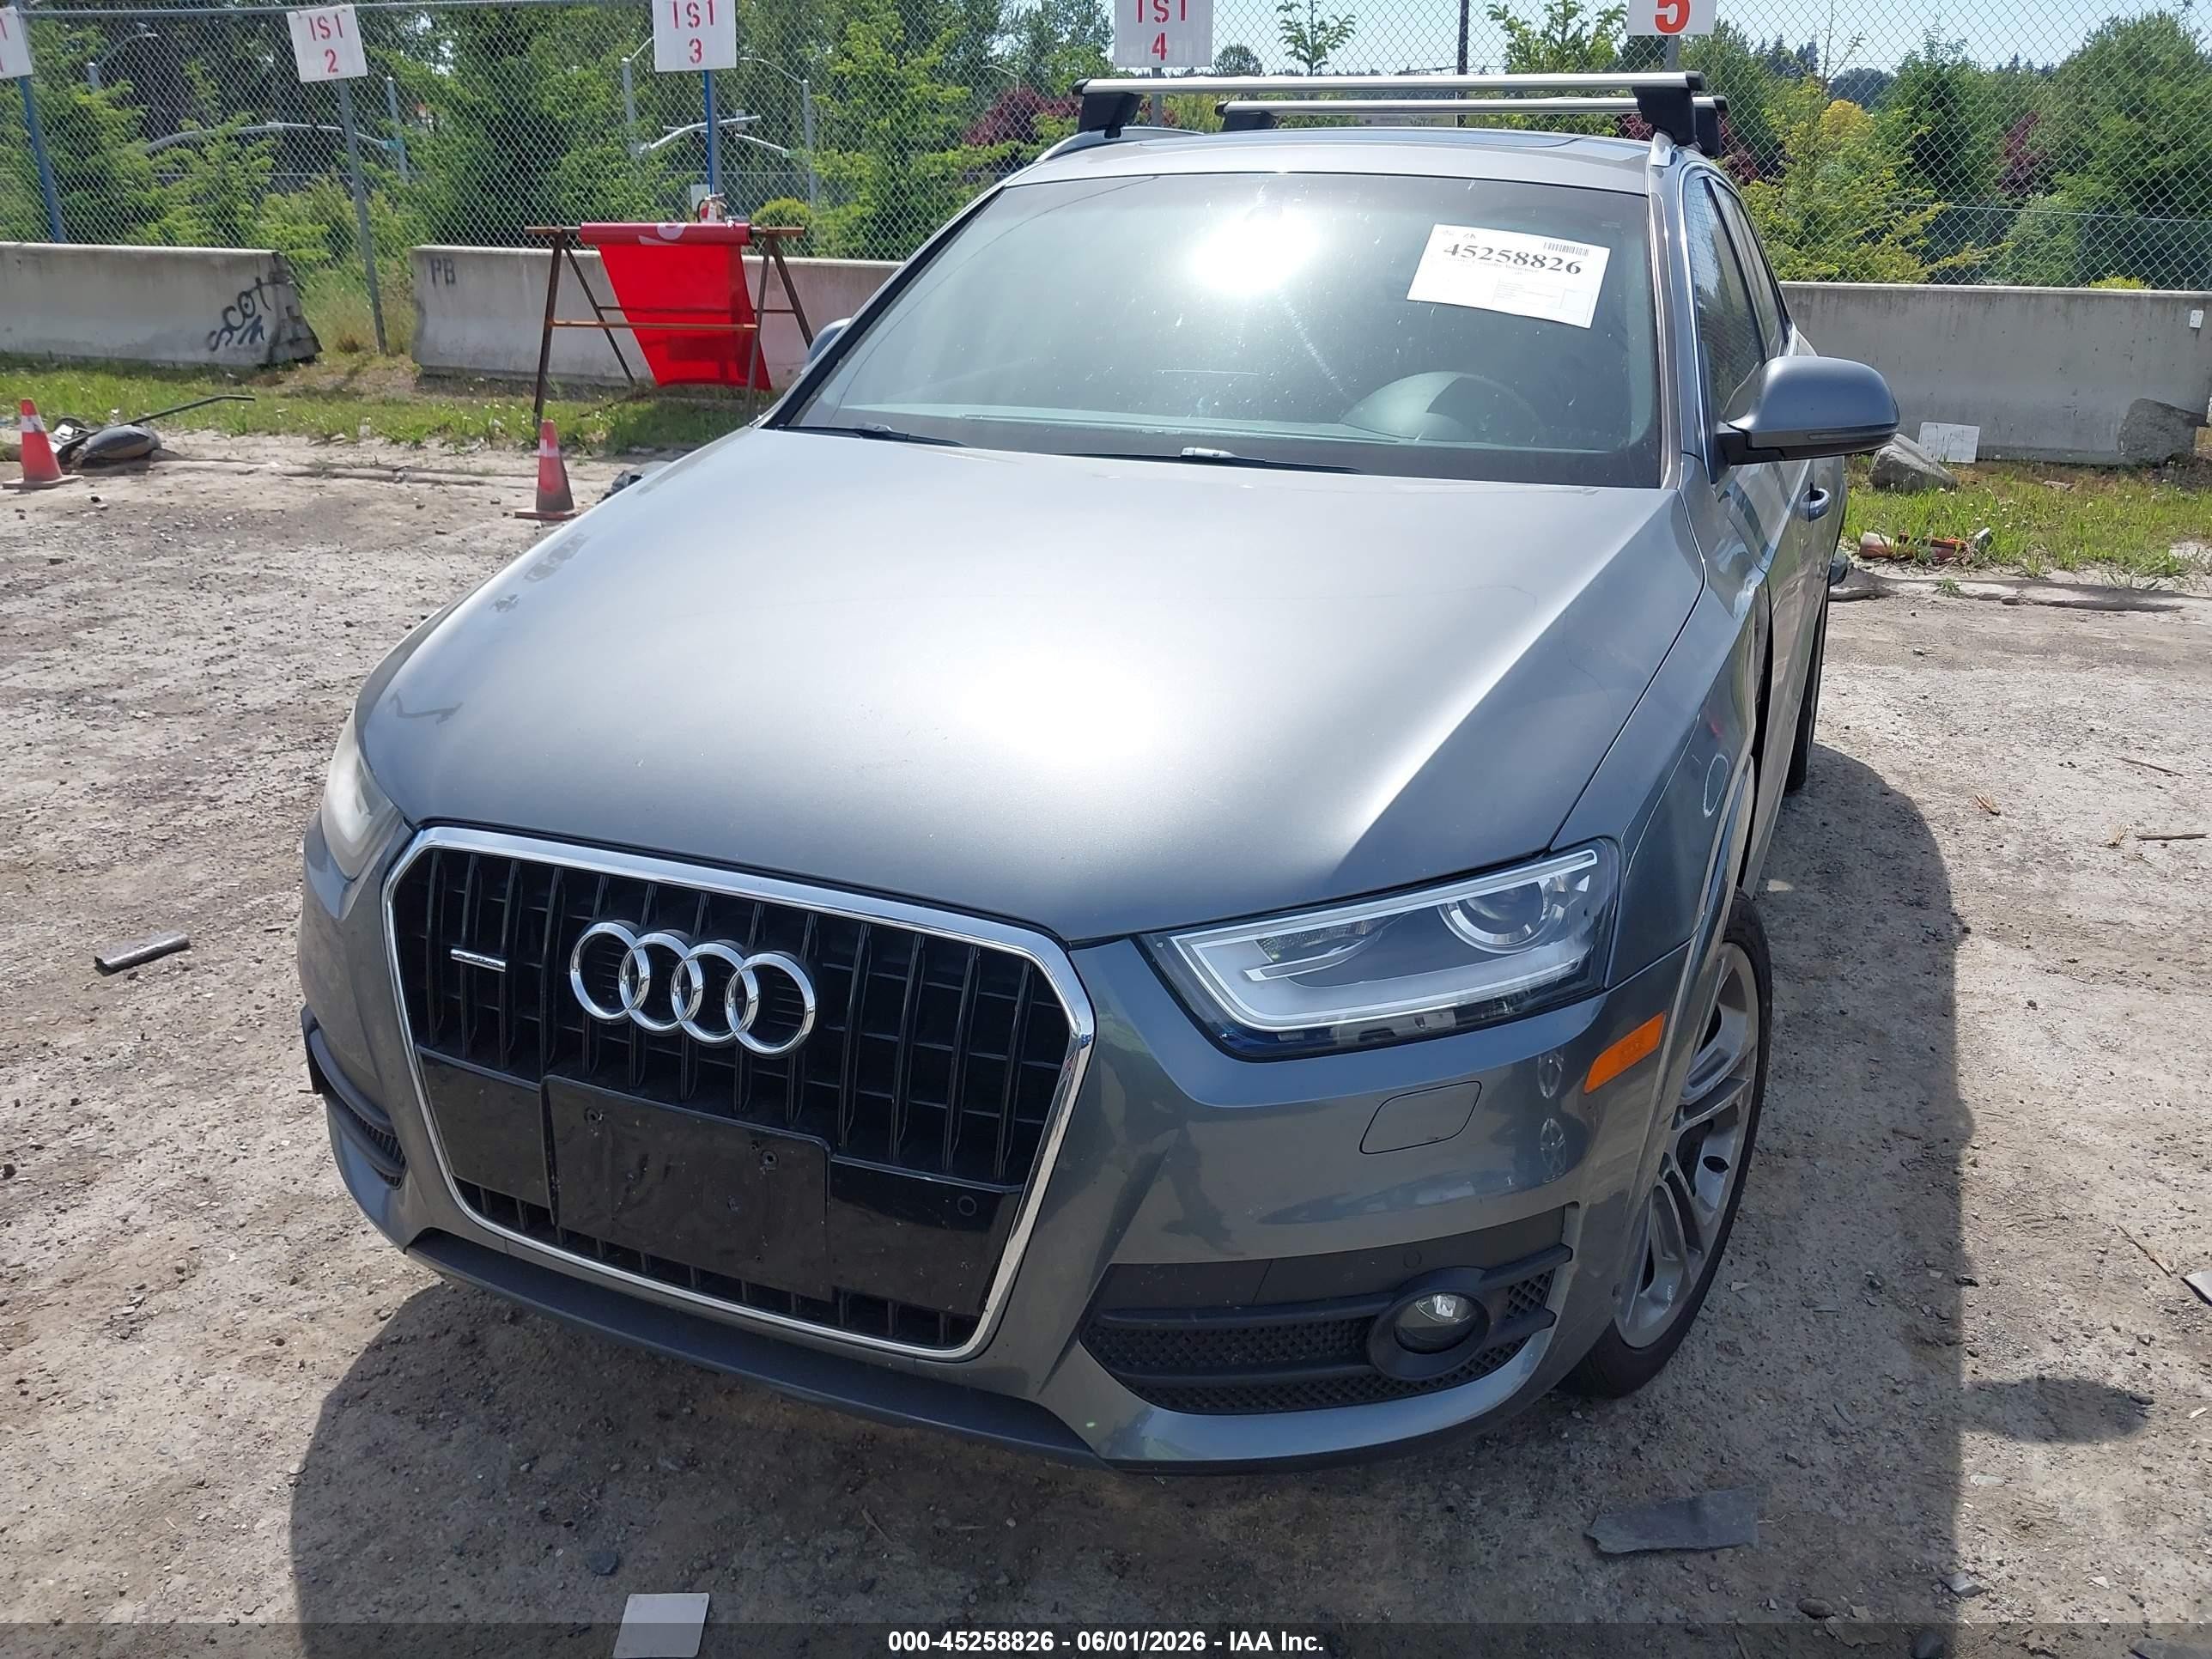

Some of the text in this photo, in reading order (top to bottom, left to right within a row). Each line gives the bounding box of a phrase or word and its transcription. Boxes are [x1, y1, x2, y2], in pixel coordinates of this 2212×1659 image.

[689, 38, 702, 64] 3
[1152, 32, 1168, 61] 4
[325, 48, 339, 73] 2
[1443, 242, 1583, 275] 45258826
